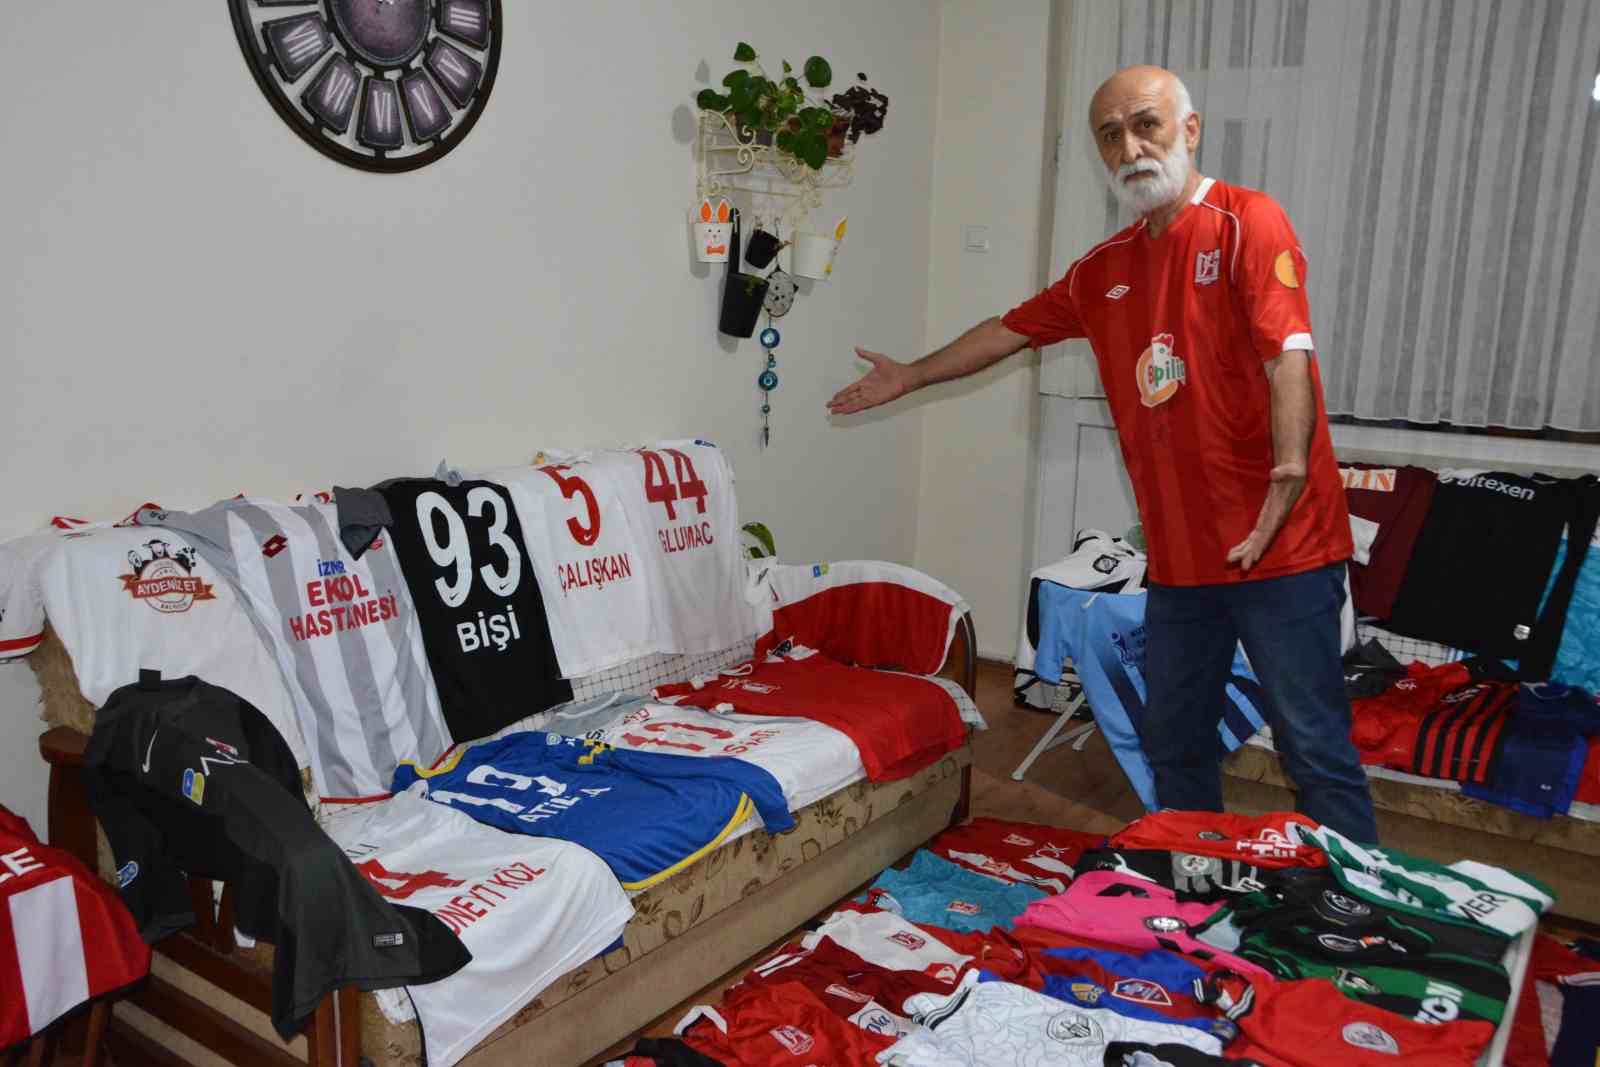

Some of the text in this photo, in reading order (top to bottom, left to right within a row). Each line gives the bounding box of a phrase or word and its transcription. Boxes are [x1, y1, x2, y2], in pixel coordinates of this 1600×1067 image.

[536, 464, 600, 546] 5
[636, 449, 708, 520] 44
[415, 486, 521, 608] 93
[306, 575, 369, 607] EKOL
[558, 552, 632, 598] ÇALIŞKAN
[289, 590, 398, 641] HASTANESİ
[456, 604, 521, 653] BİŞİ
